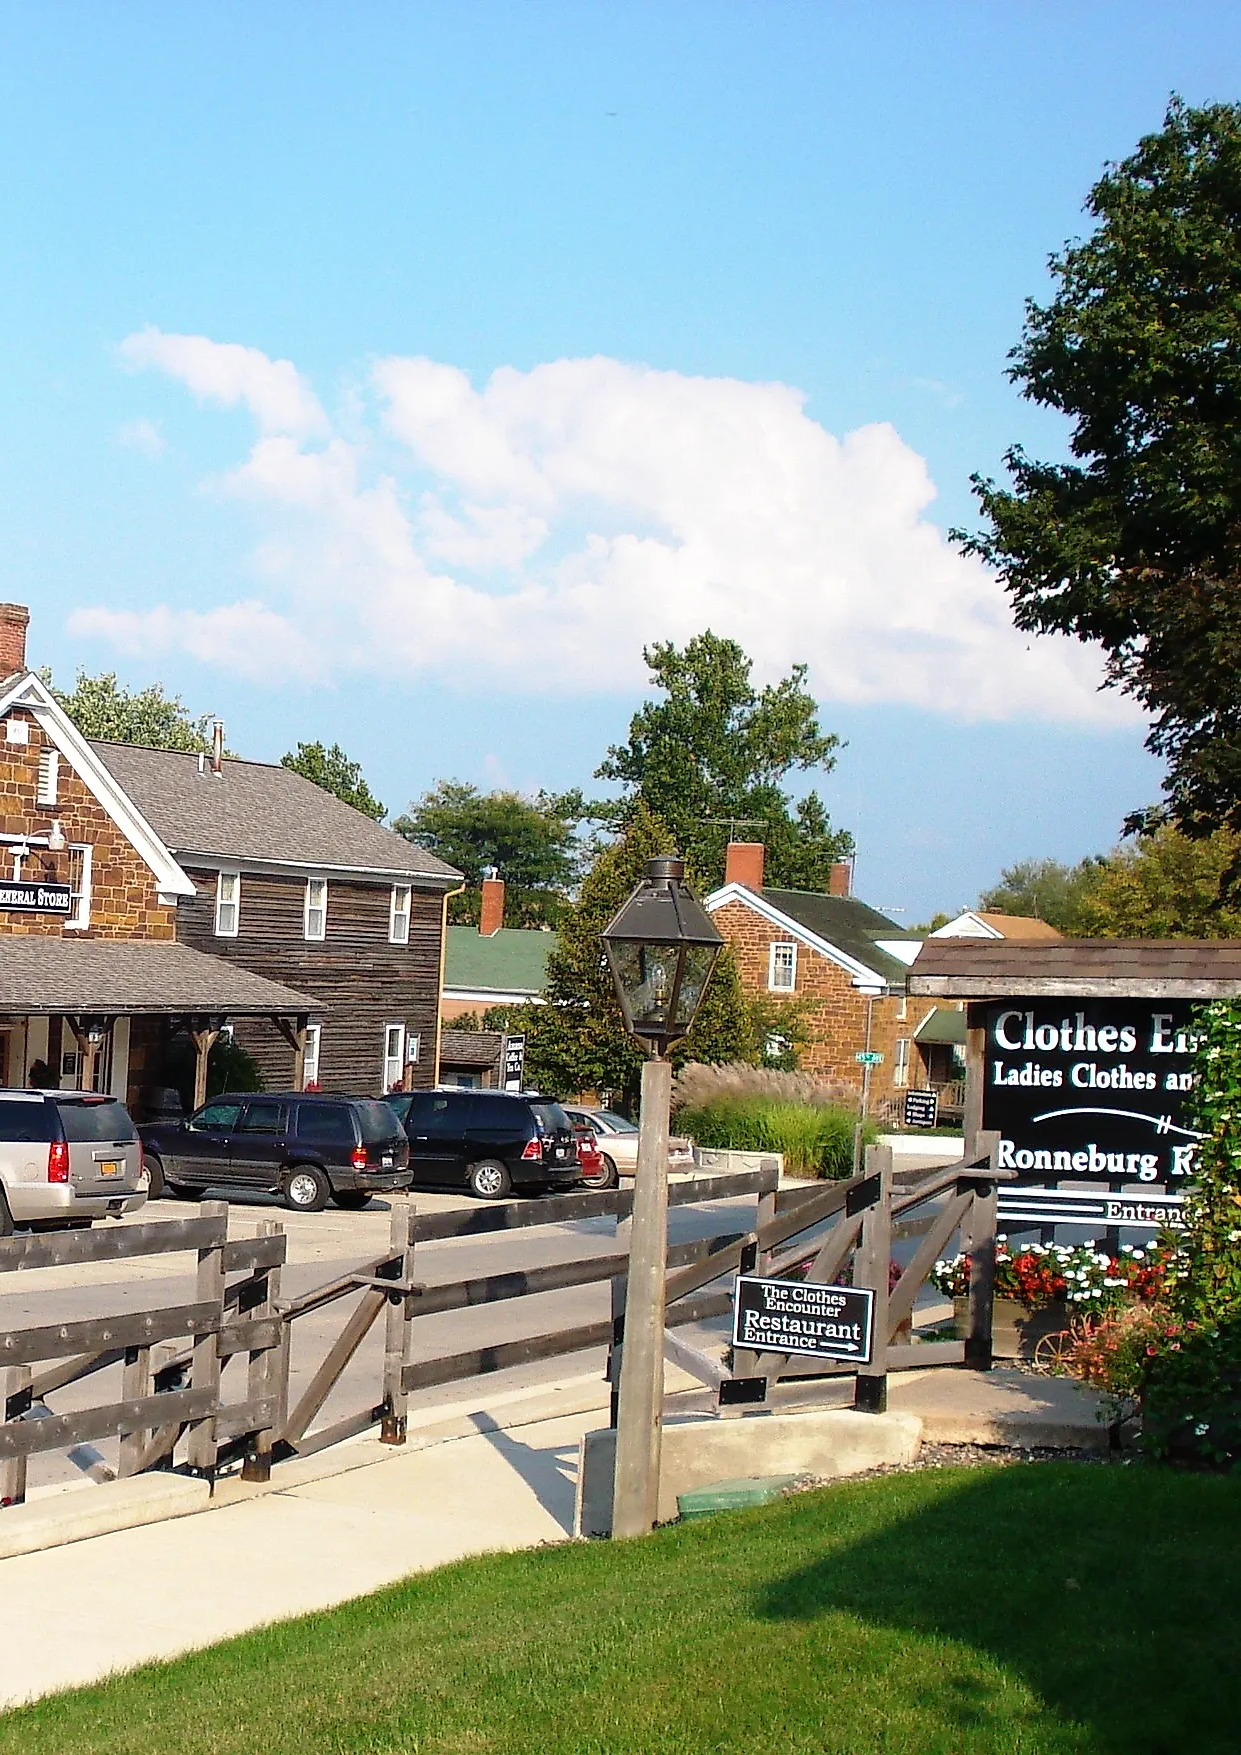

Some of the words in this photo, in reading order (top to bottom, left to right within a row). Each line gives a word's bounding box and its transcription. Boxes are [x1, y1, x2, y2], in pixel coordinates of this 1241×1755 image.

[38, 888, 69, 907] STORE
[995, 1010, 1137, 1053] Clothes
[993, 1061, 1063, 1087] Ladies
[1071, 1062, 1157, 1090] Clothes
[998, 1139, 1159, 1182] Ronneburg
[761, 1284, 789, 1300] The
[792, 1288, 846, 1306] Clothes
[765, 1297, 842, 1318] Encounter
[744, 1309, 861, 1341] Restaurant
[744, 1327, 817, 1348] Entrance
